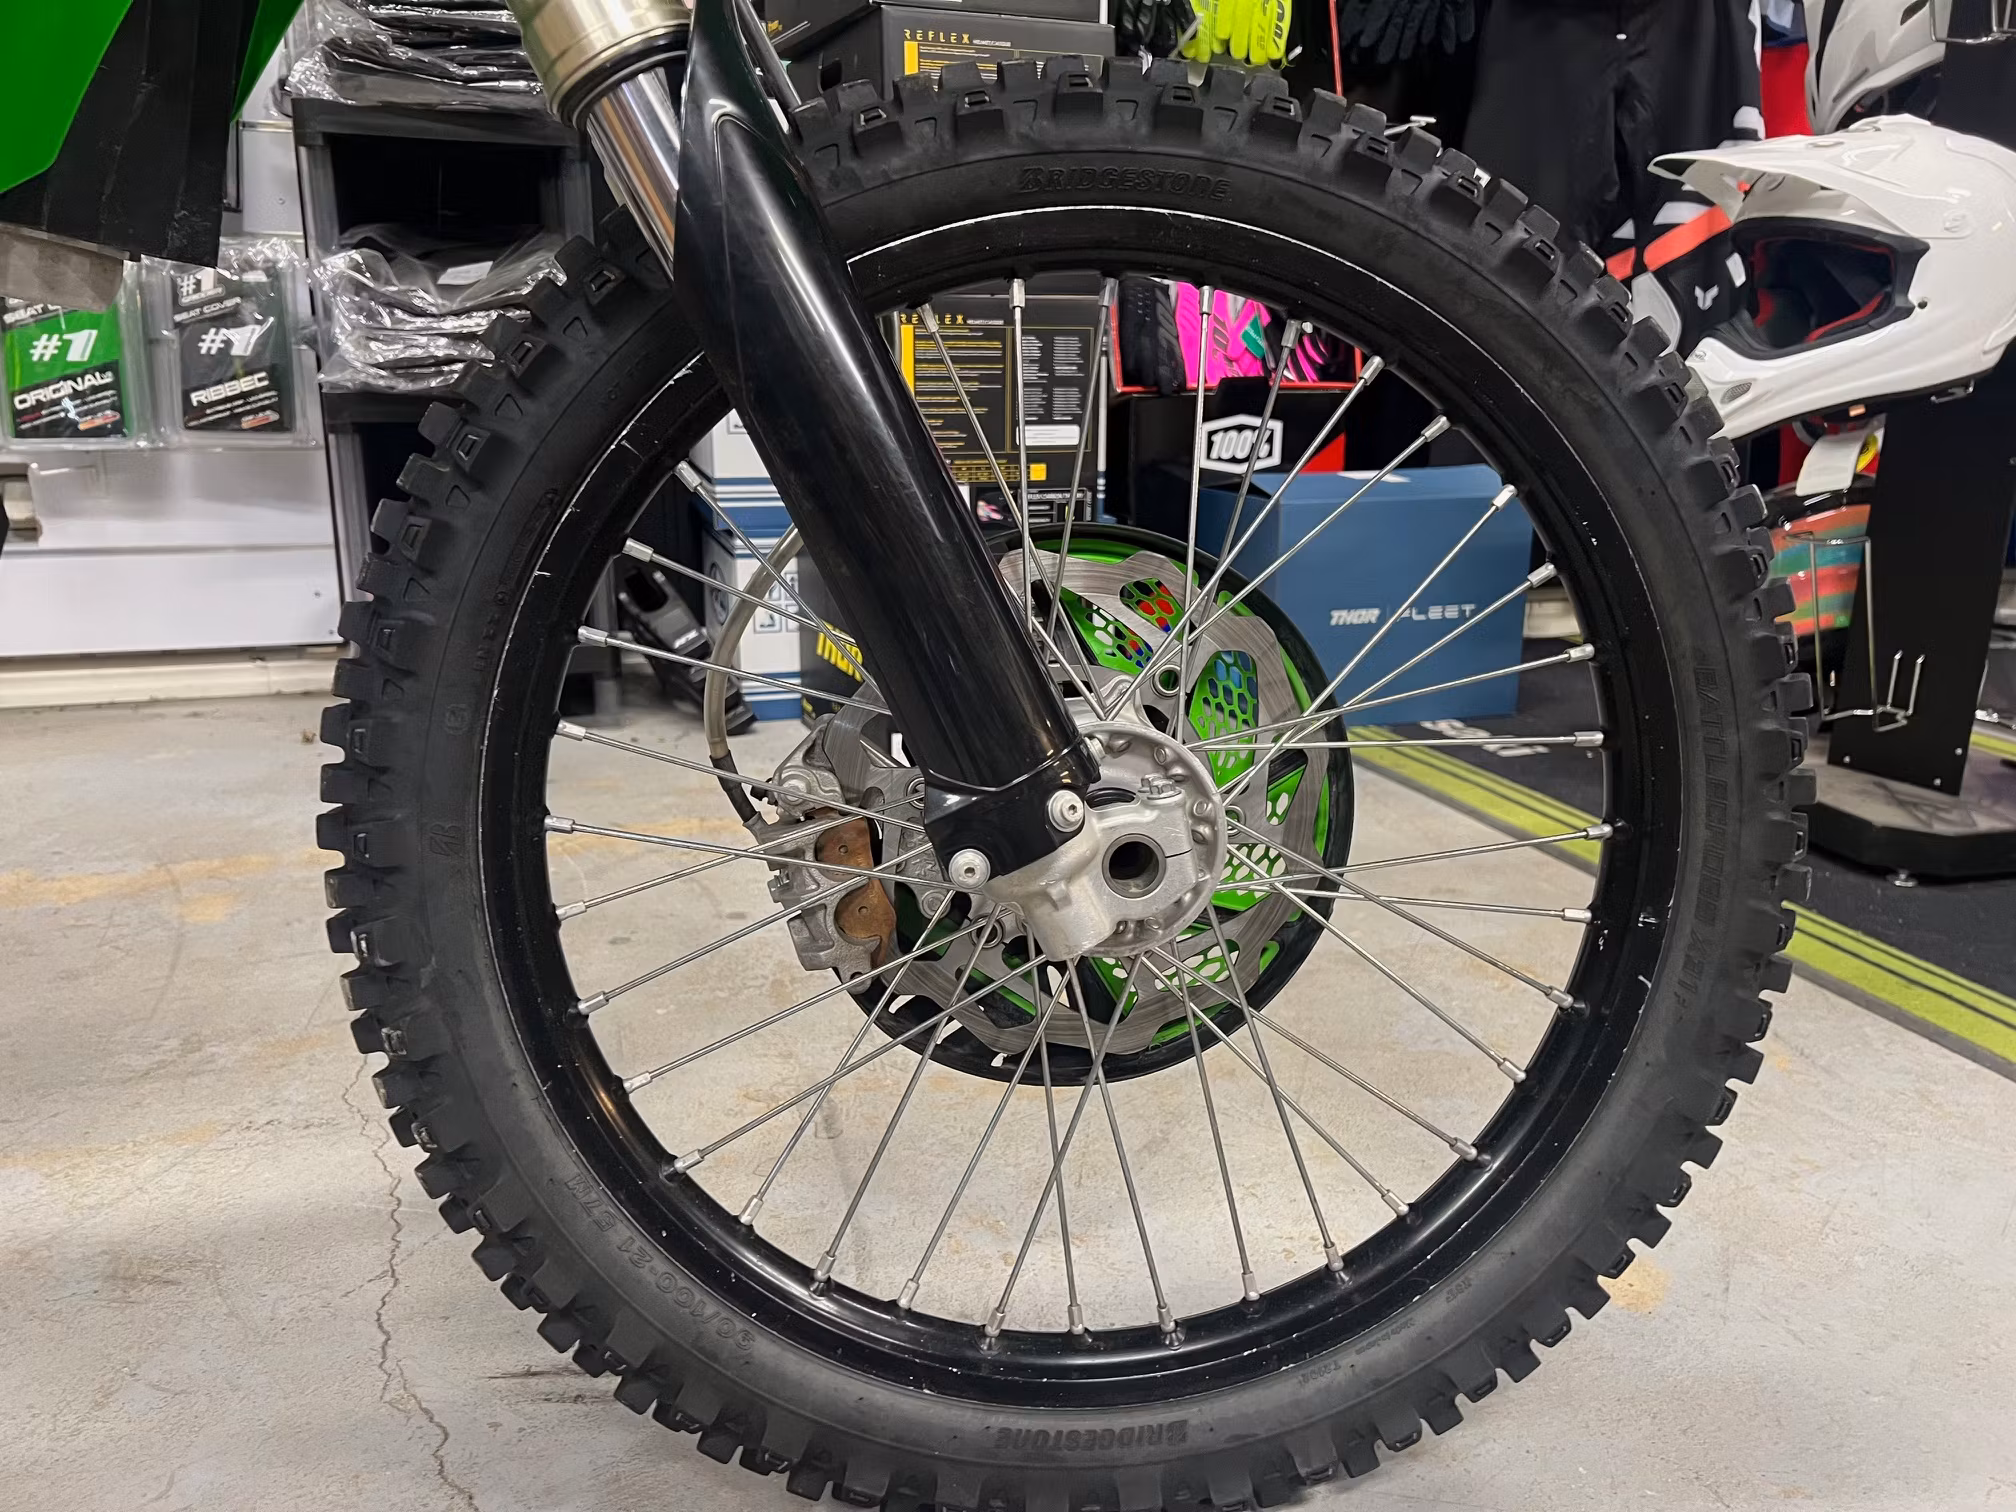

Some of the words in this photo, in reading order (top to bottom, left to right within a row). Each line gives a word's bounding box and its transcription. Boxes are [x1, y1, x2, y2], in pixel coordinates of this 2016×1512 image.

[903, 29, 970, 44] REFLEX
[1019, 166, 1232, 200] BRIDGESTONE
[173, 309, 202, 323] SEAT
[203, 297, 242, 314] COVER
[900, 313, 964, 325] RELEX
[30, 329, 98, 362] #1
[13, 371, 109, 410] ORIGINAL
[1210, 429, 1272, 460] 100%
[1330, 607, 1381, 627] THOR
[994, 1419, 1188, 1452] BRIDGESTONE
